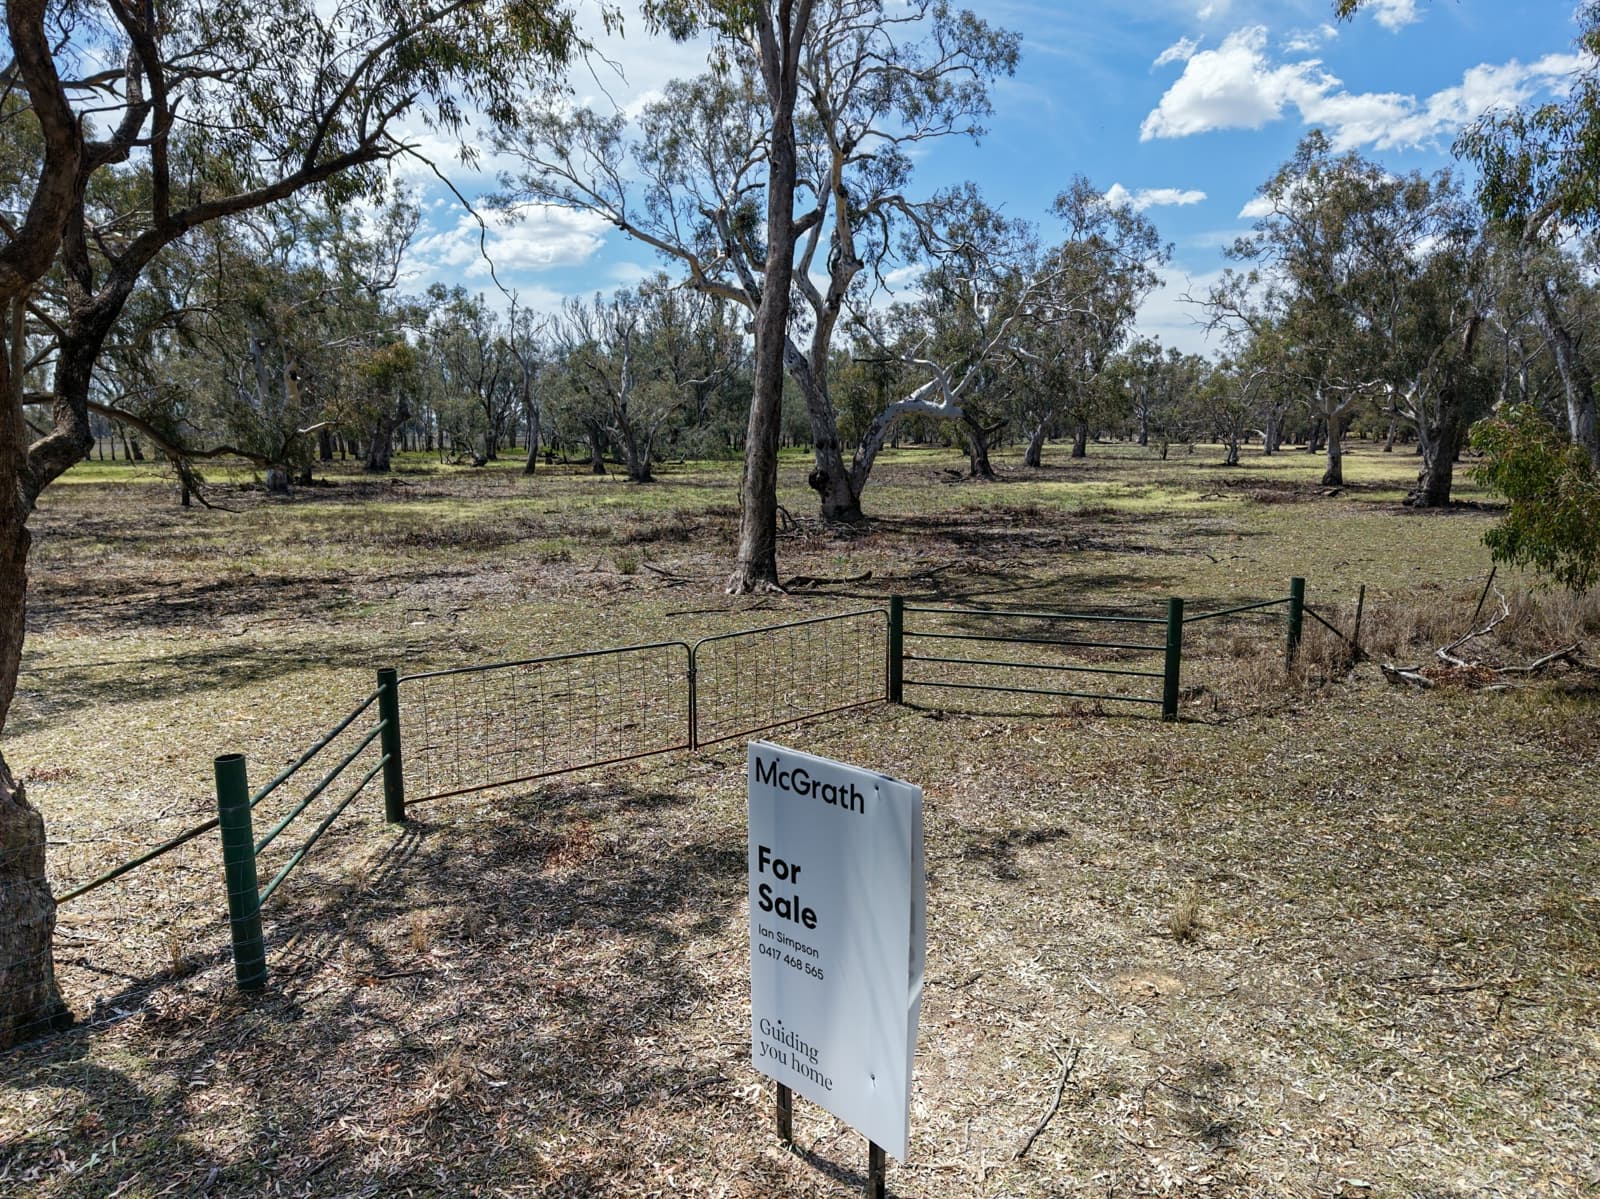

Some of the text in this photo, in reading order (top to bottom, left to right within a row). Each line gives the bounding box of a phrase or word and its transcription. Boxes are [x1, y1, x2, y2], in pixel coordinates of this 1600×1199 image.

[756, 757, 864, 814] McGrath
[758, 845, 801, 884] For
[758, 883, 818, 929] Sale
[758, 924, 819, 959] Ian Simpson
[759, 943, 824, 980] 0417 468 565
[760, 1018, 819, 1064] Guiding
[760, 1041, 833, 1091] you home
